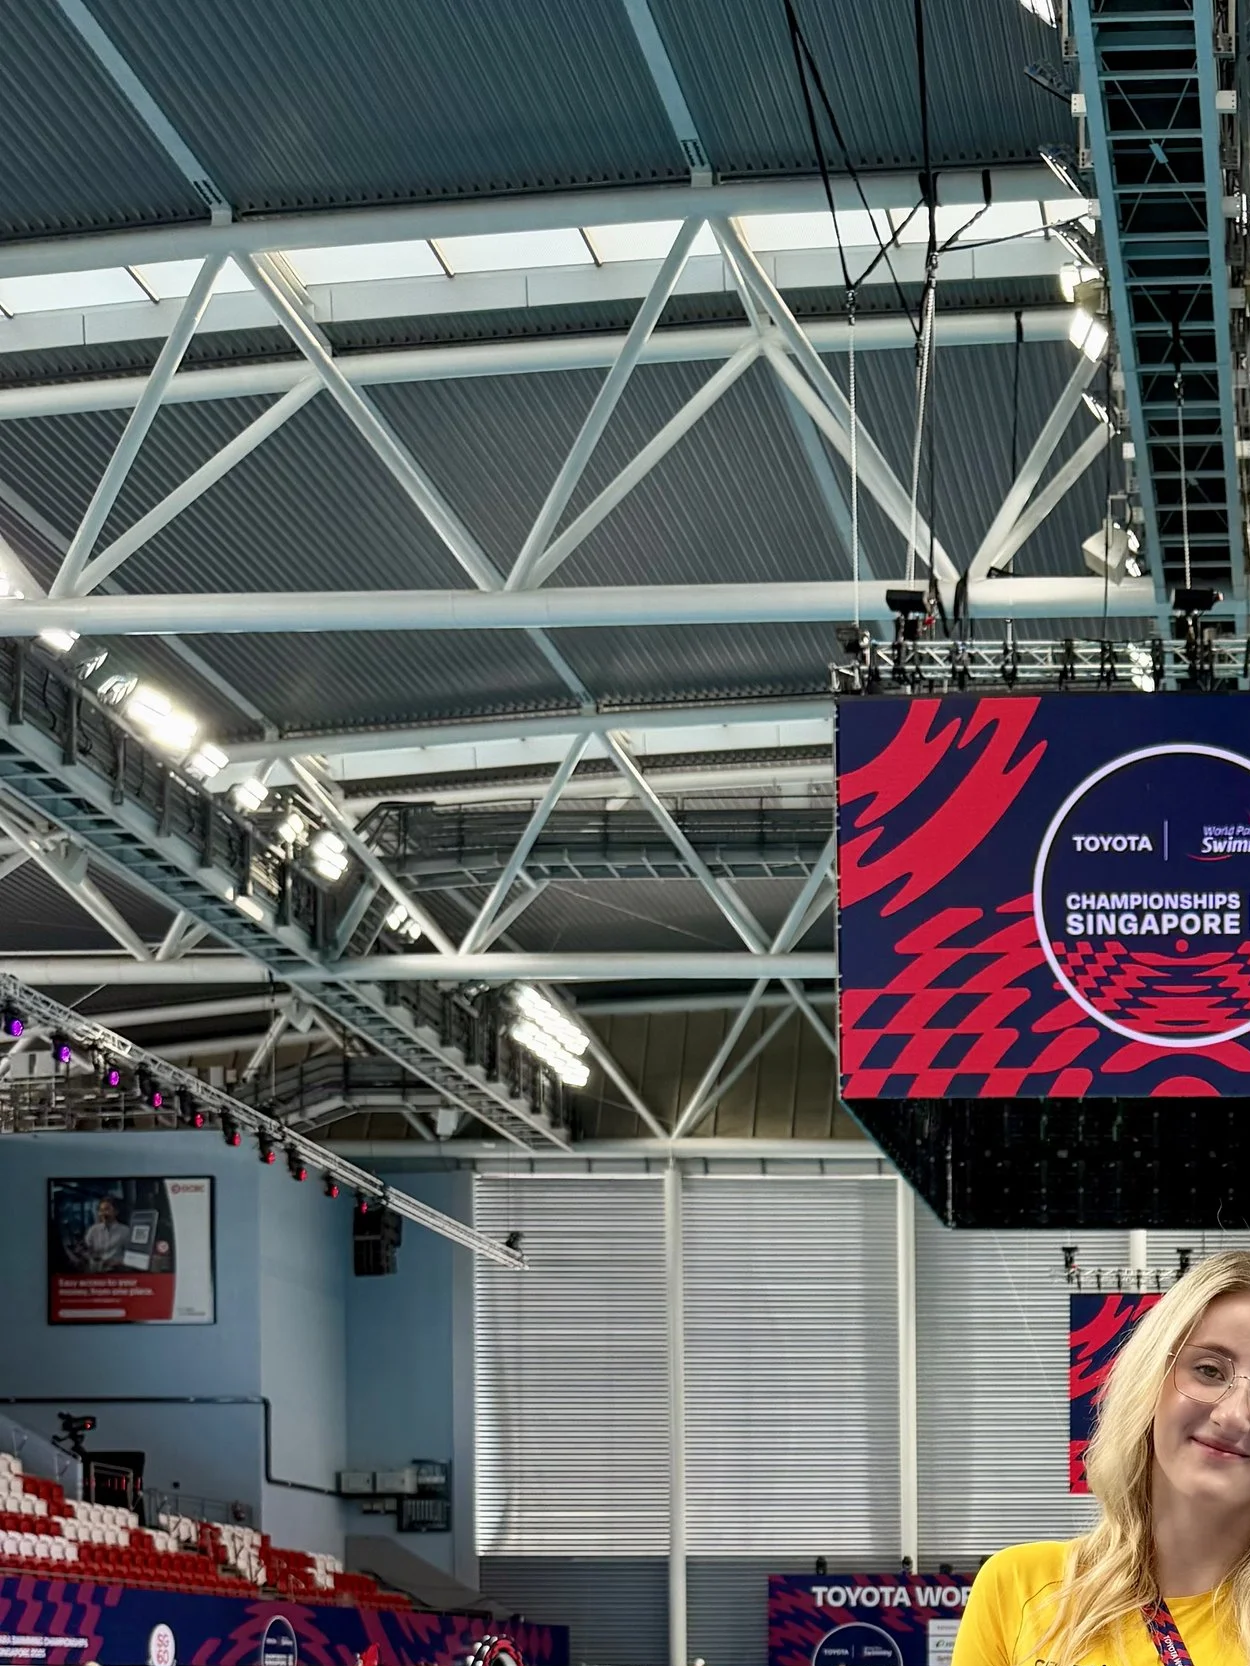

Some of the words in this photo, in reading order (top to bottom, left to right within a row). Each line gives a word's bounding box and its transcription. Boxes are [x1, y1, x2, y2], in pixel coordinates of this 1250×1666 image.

[1203, 825, 1235, 837] World
[1072, 834, 1153, 852] TOYOTA
[1066, 892, 1241, 911] CHAMPIONSHIPS
[1066, 913, 1241, 935] SINGAPORE
[812, 1586, 911, 1607] TOYOTA
[824, 1648, 849, 1656] TOYOTA
[1164, 1635, 1178, 1660] TOYOTA
